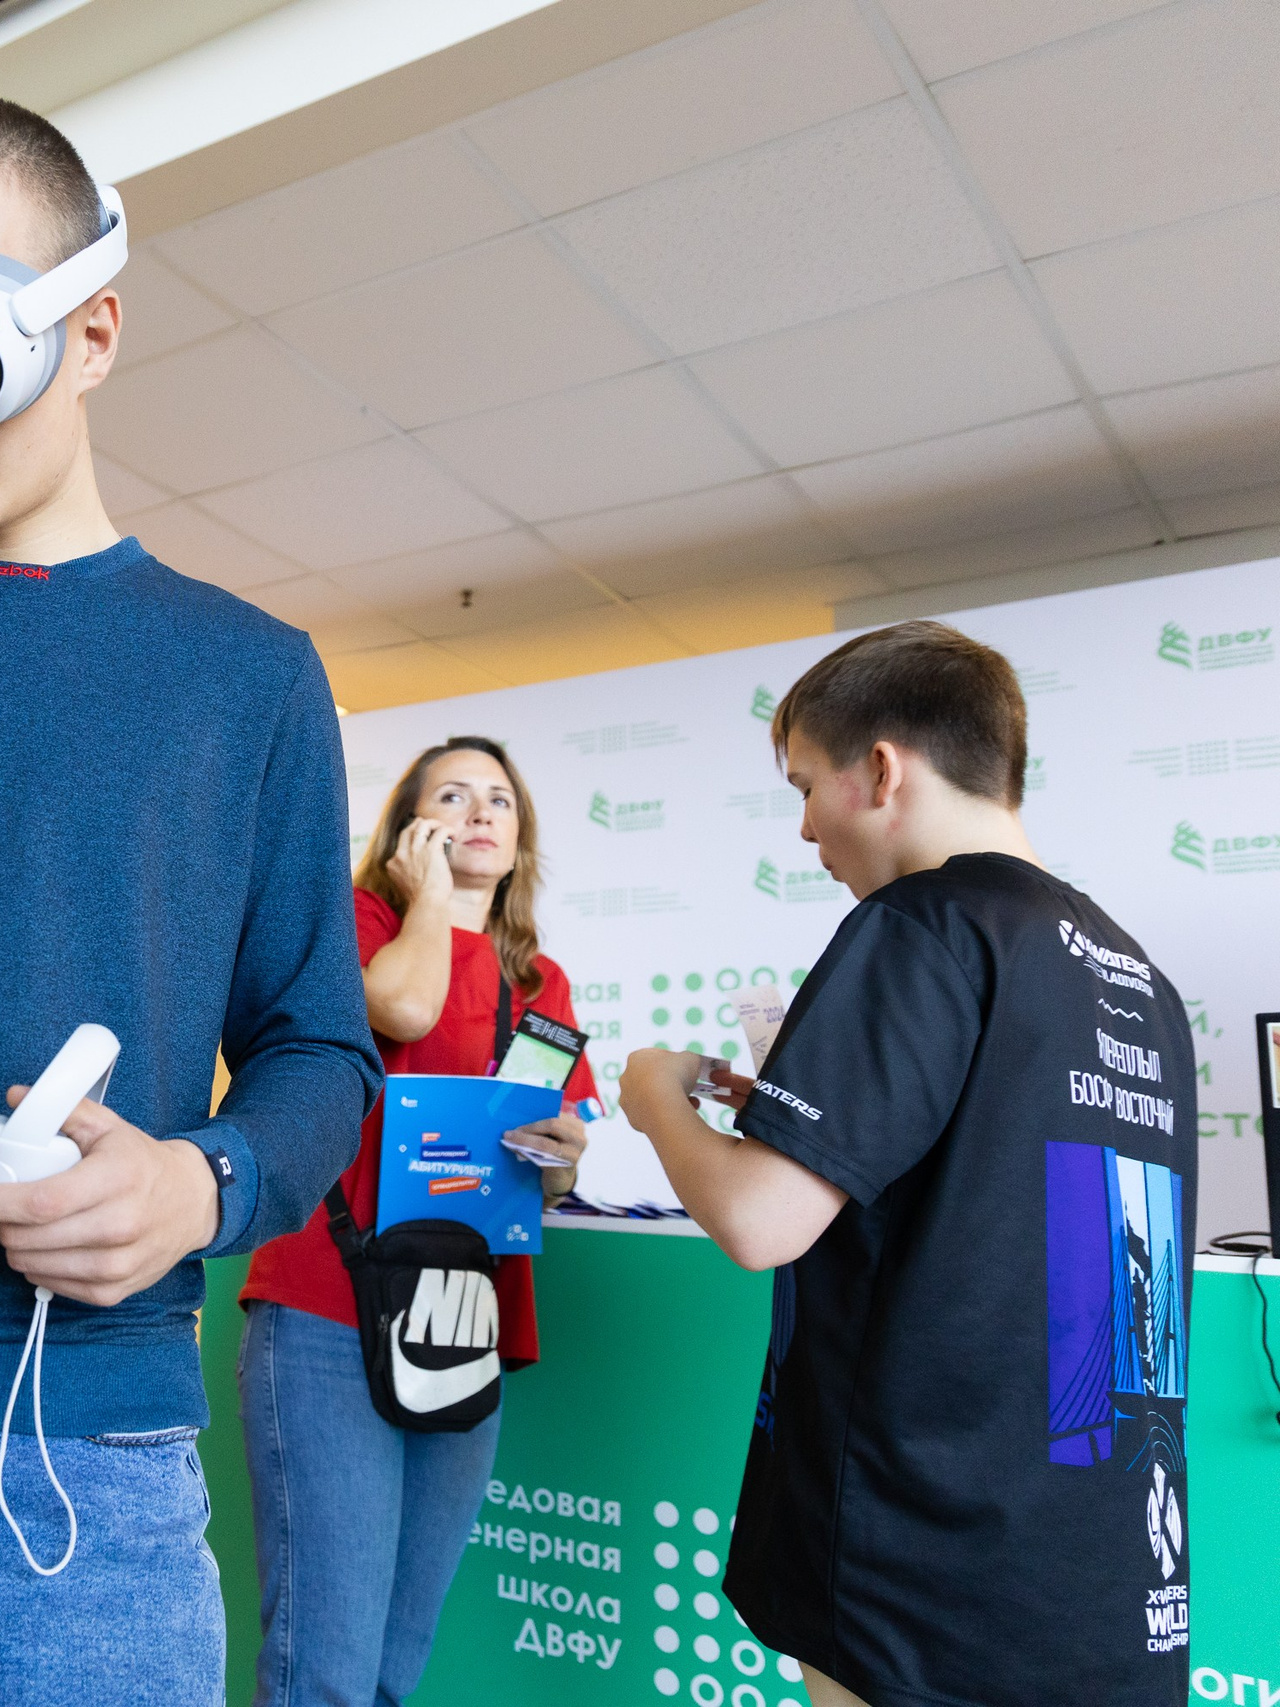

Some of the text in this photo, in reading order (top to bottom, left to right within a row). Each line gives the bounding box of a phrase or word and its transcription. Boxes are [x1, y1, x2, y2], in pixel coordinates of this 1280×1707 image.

[408, 1159, 494, 1177] АБИТУРИЕНТ
[497, 1573, 621, 1624] школа
[514, 1617, 622, 1670] ДВФУ
